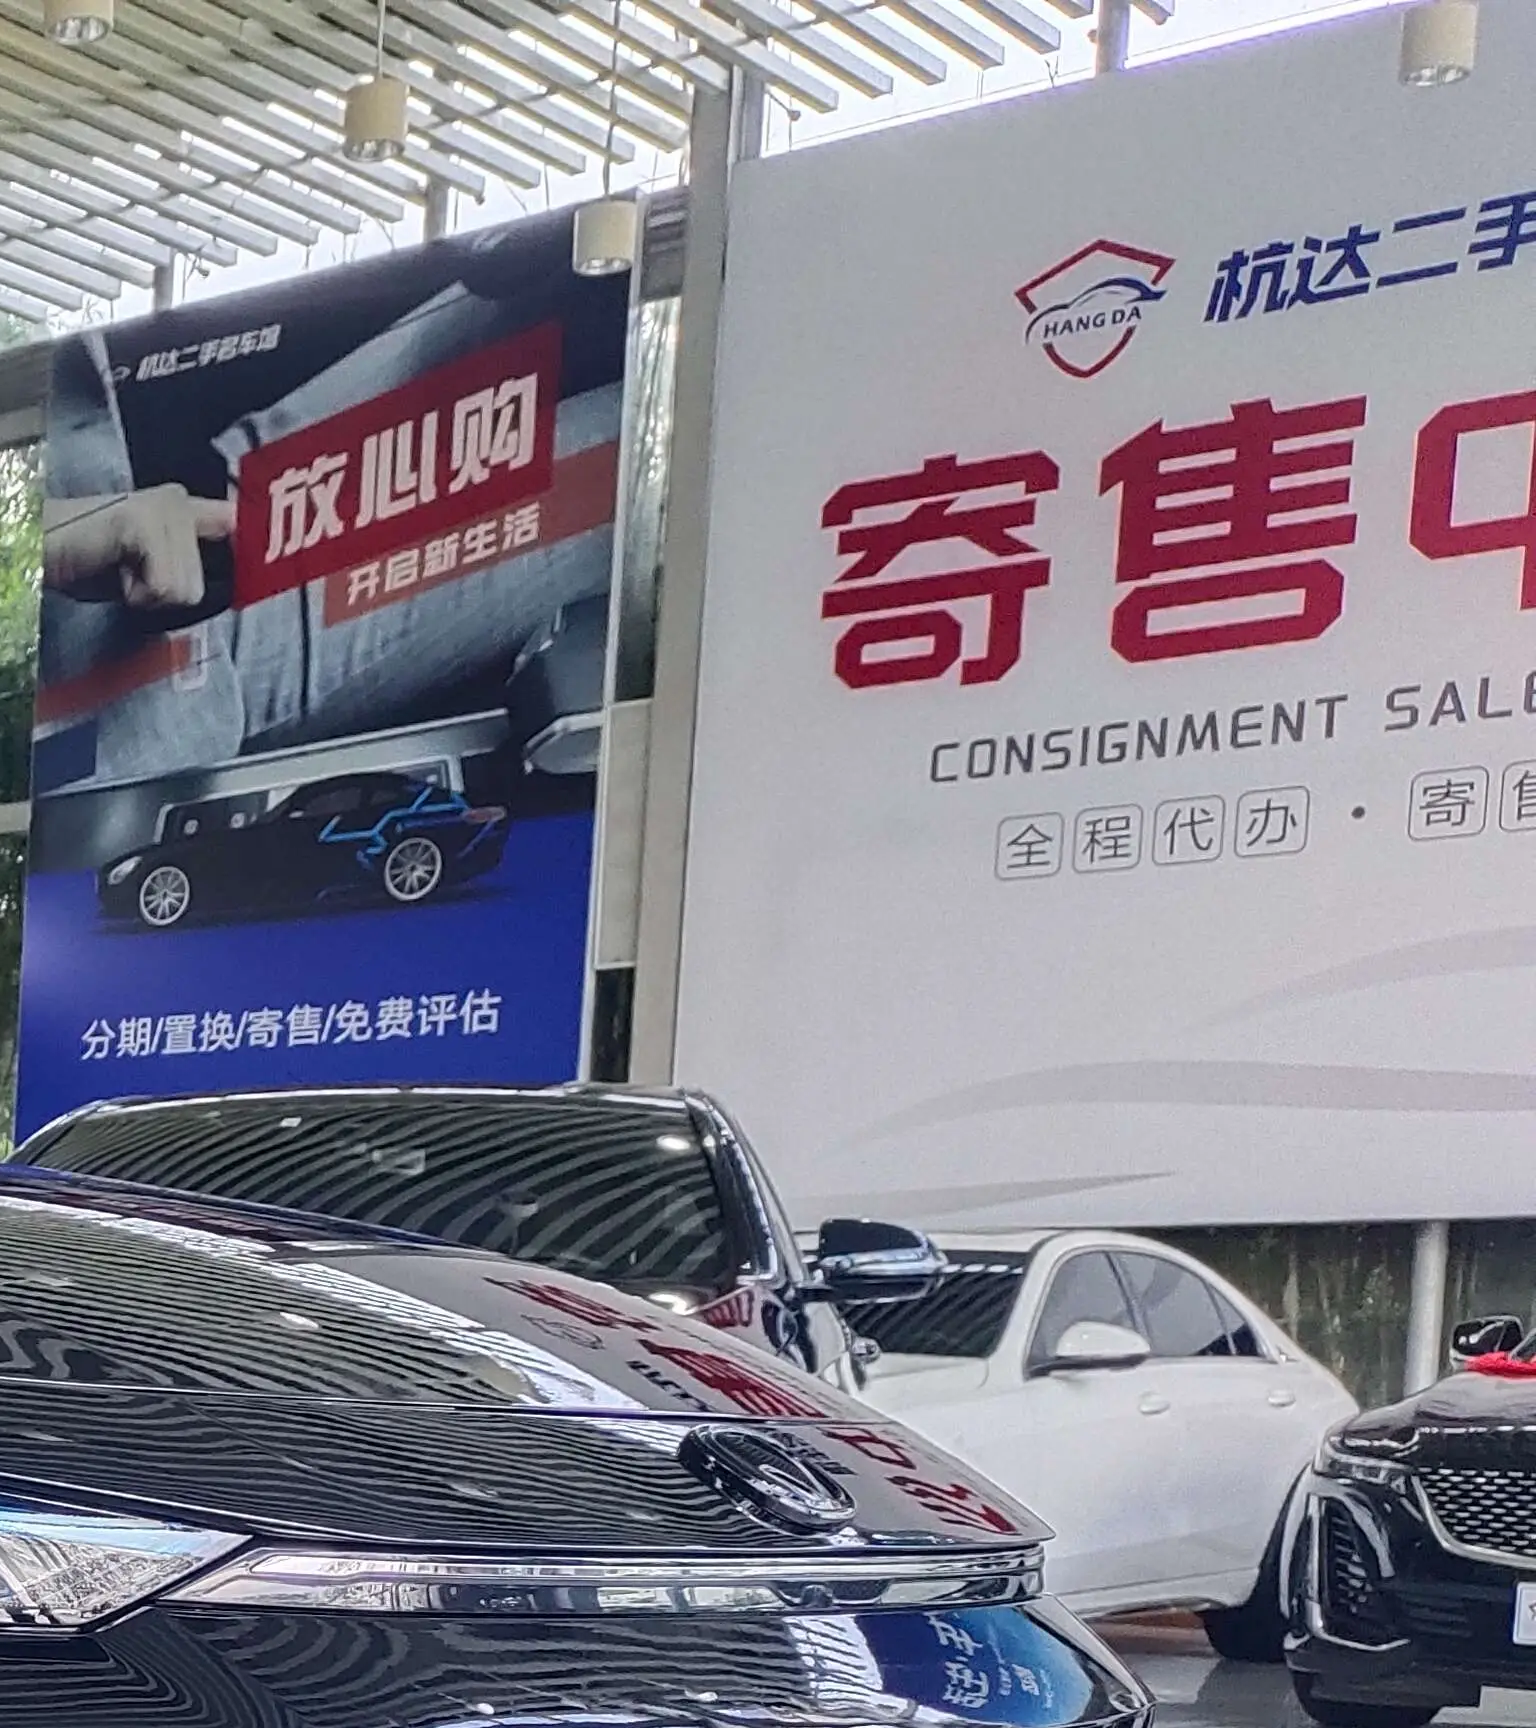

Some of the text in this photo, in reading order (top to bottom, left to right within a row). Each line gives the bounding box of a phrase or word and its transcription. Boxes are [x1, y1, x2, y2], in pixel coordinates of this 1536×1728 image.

[1043, 305, 1142, 339] HANG DA
[264, 372, 539, 564] 放心购
[347, 501, 541, 606] 开启新生活
[930, 671, 1536, 782] CONSIGNMENT SAL
[80, 988, 502, 1060] 分期/置换/寄售/免费评估
